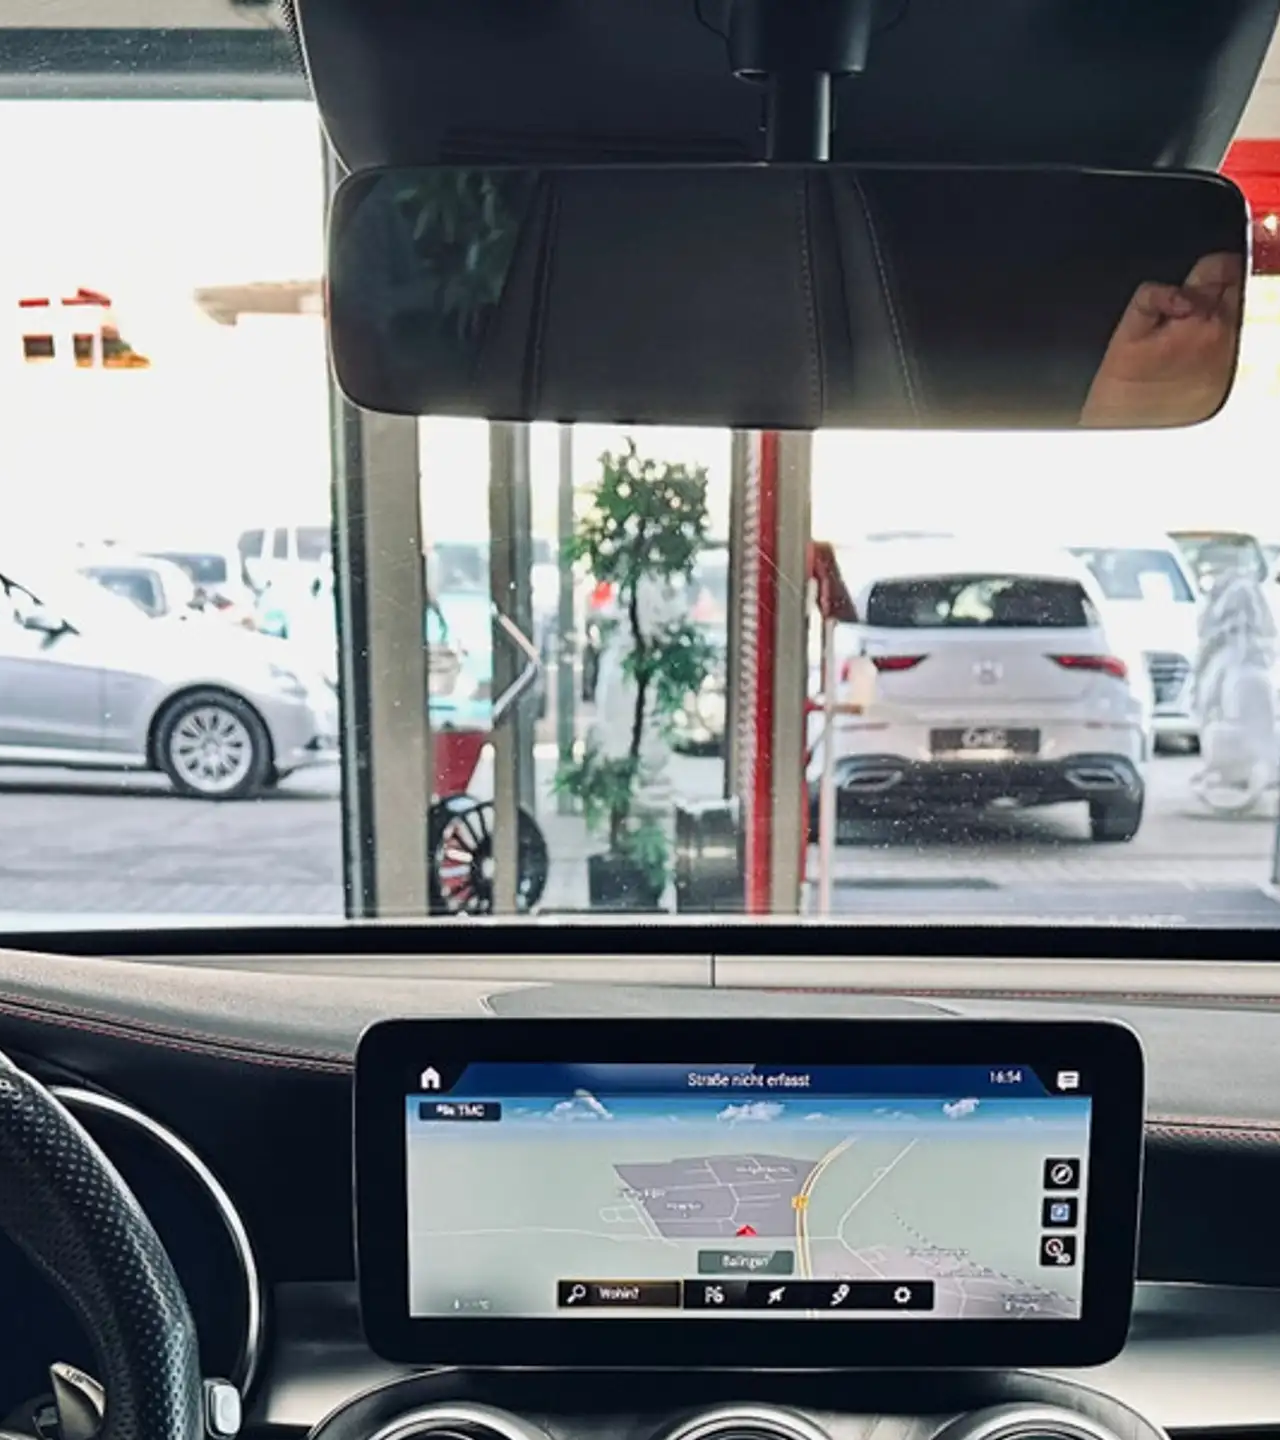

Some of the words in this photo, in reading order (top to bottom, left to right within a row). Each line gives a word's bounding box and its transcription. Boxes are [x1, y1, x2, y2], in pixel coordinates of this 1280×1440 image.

[687, 1072, 729, 1088] Straße
[732, 1072, 764, 1087] nicht
[766, 1072, 811, 1088] erfasst
